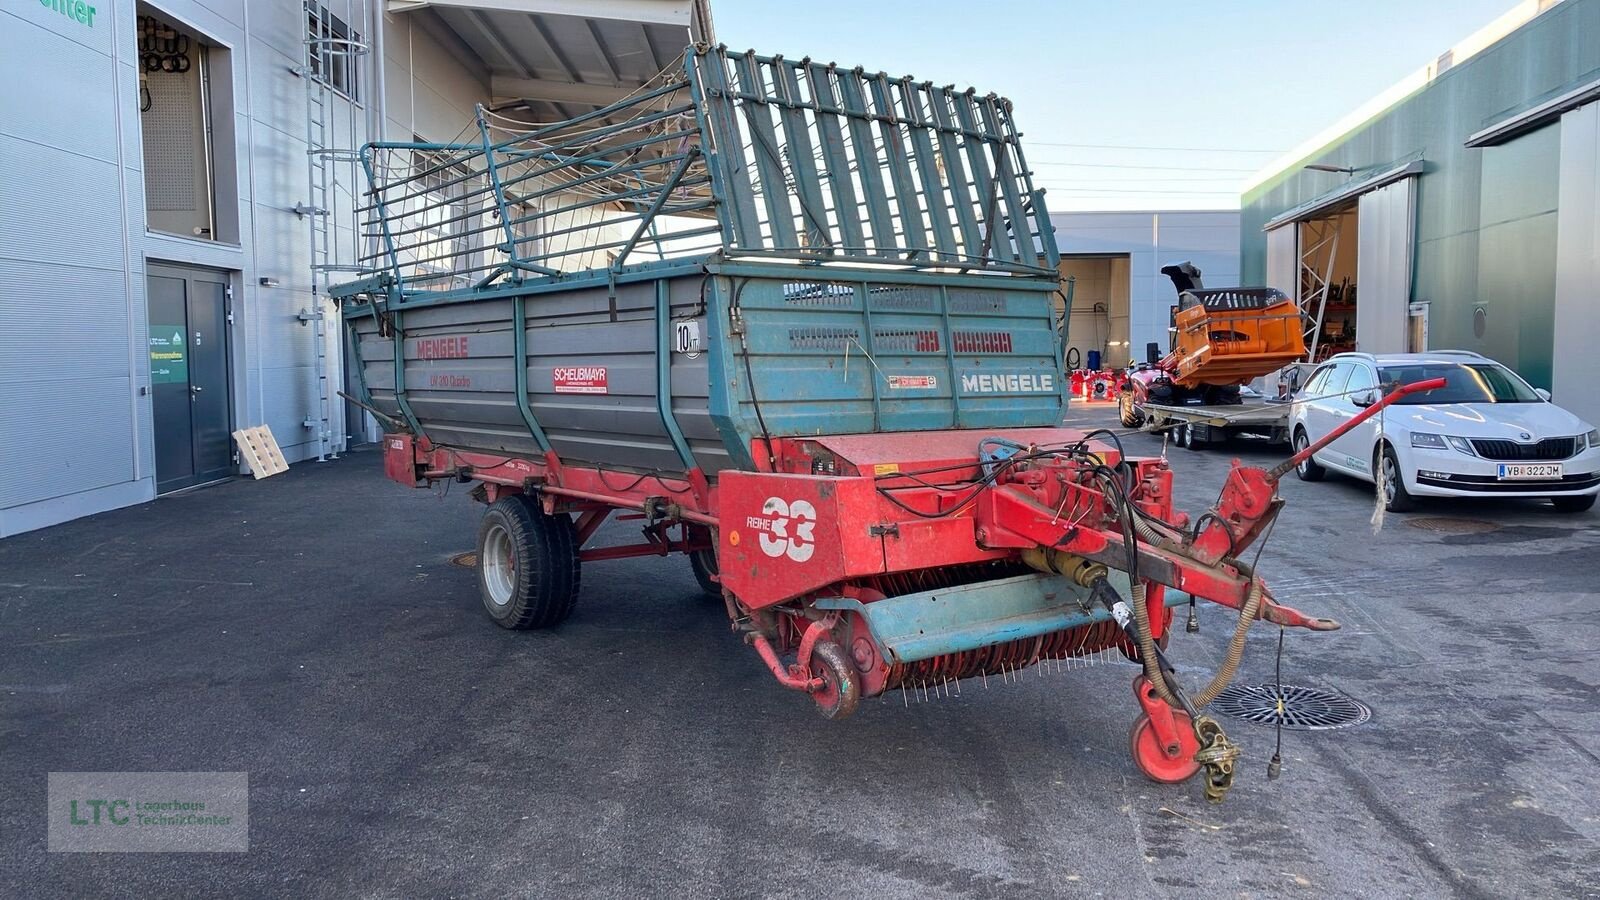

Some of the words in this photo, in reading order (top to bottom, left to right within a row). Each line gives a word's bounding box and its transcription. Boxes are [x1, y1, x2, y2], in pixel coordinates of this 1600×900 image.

[678, 326, 689, 351] 10
[417, 336, 468, 360] MENGELE
[554, 368, 606, 382] SCHEUBMAYR
[963, 374, 1053, 392] MENGELE
[1507, 466, 1520, 476] VB
[1526, 466, 1545, 476] 322
[1546, 466, 1560, 476] JM
[746, 516, 771, 531] REIHE
[758, 496, 817, 563] 33
